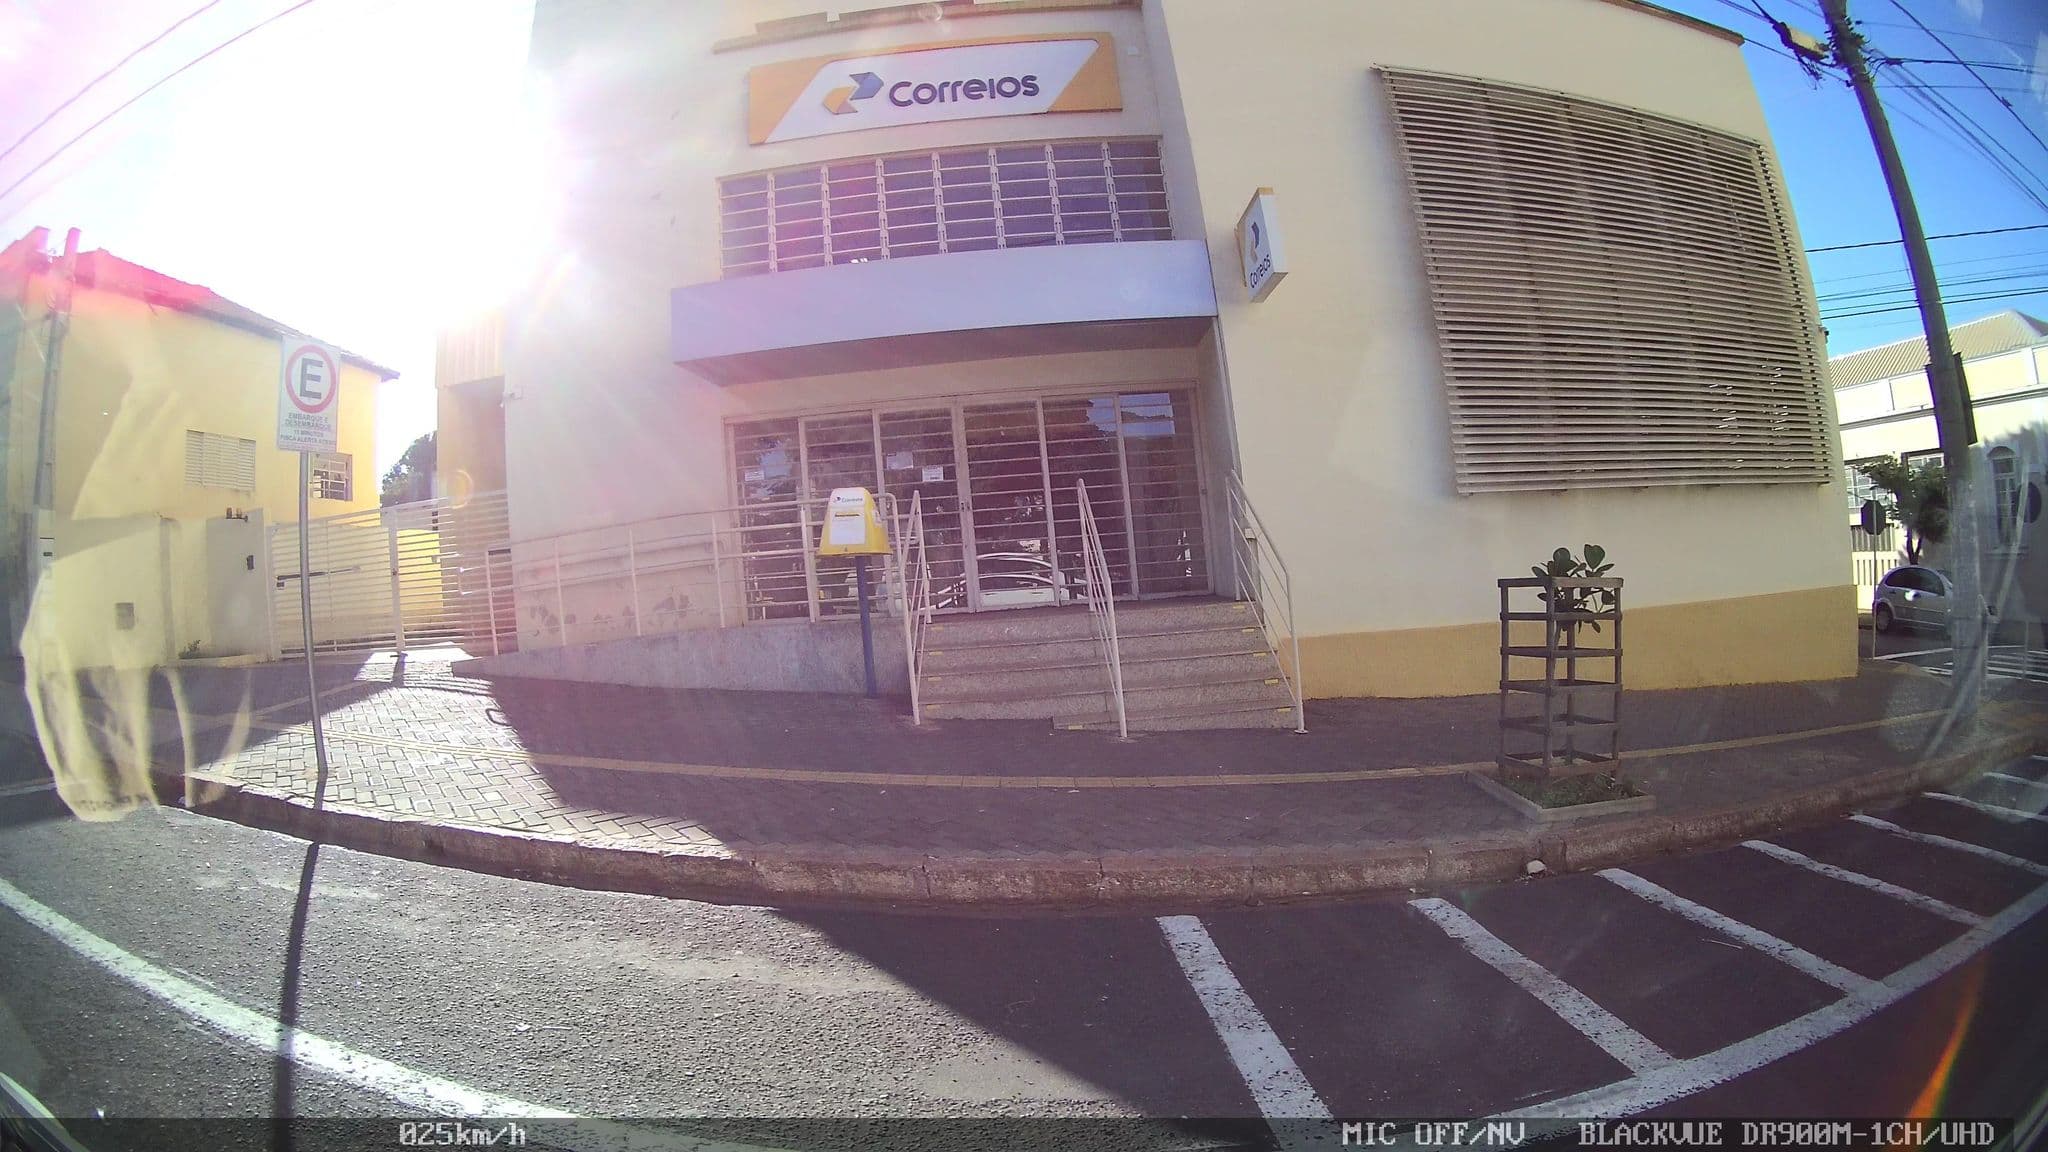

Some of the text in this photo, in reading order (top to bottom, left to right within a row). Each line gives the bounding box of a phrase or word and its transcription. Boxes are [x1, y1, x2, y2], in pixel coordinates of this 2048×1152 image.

[889, 75, 1040, 107] Correios
[1250, 254, 1271, 288] Correios
[300, 357, 324, 399] E
[288, 412, 323, 424] EMBARQUE
